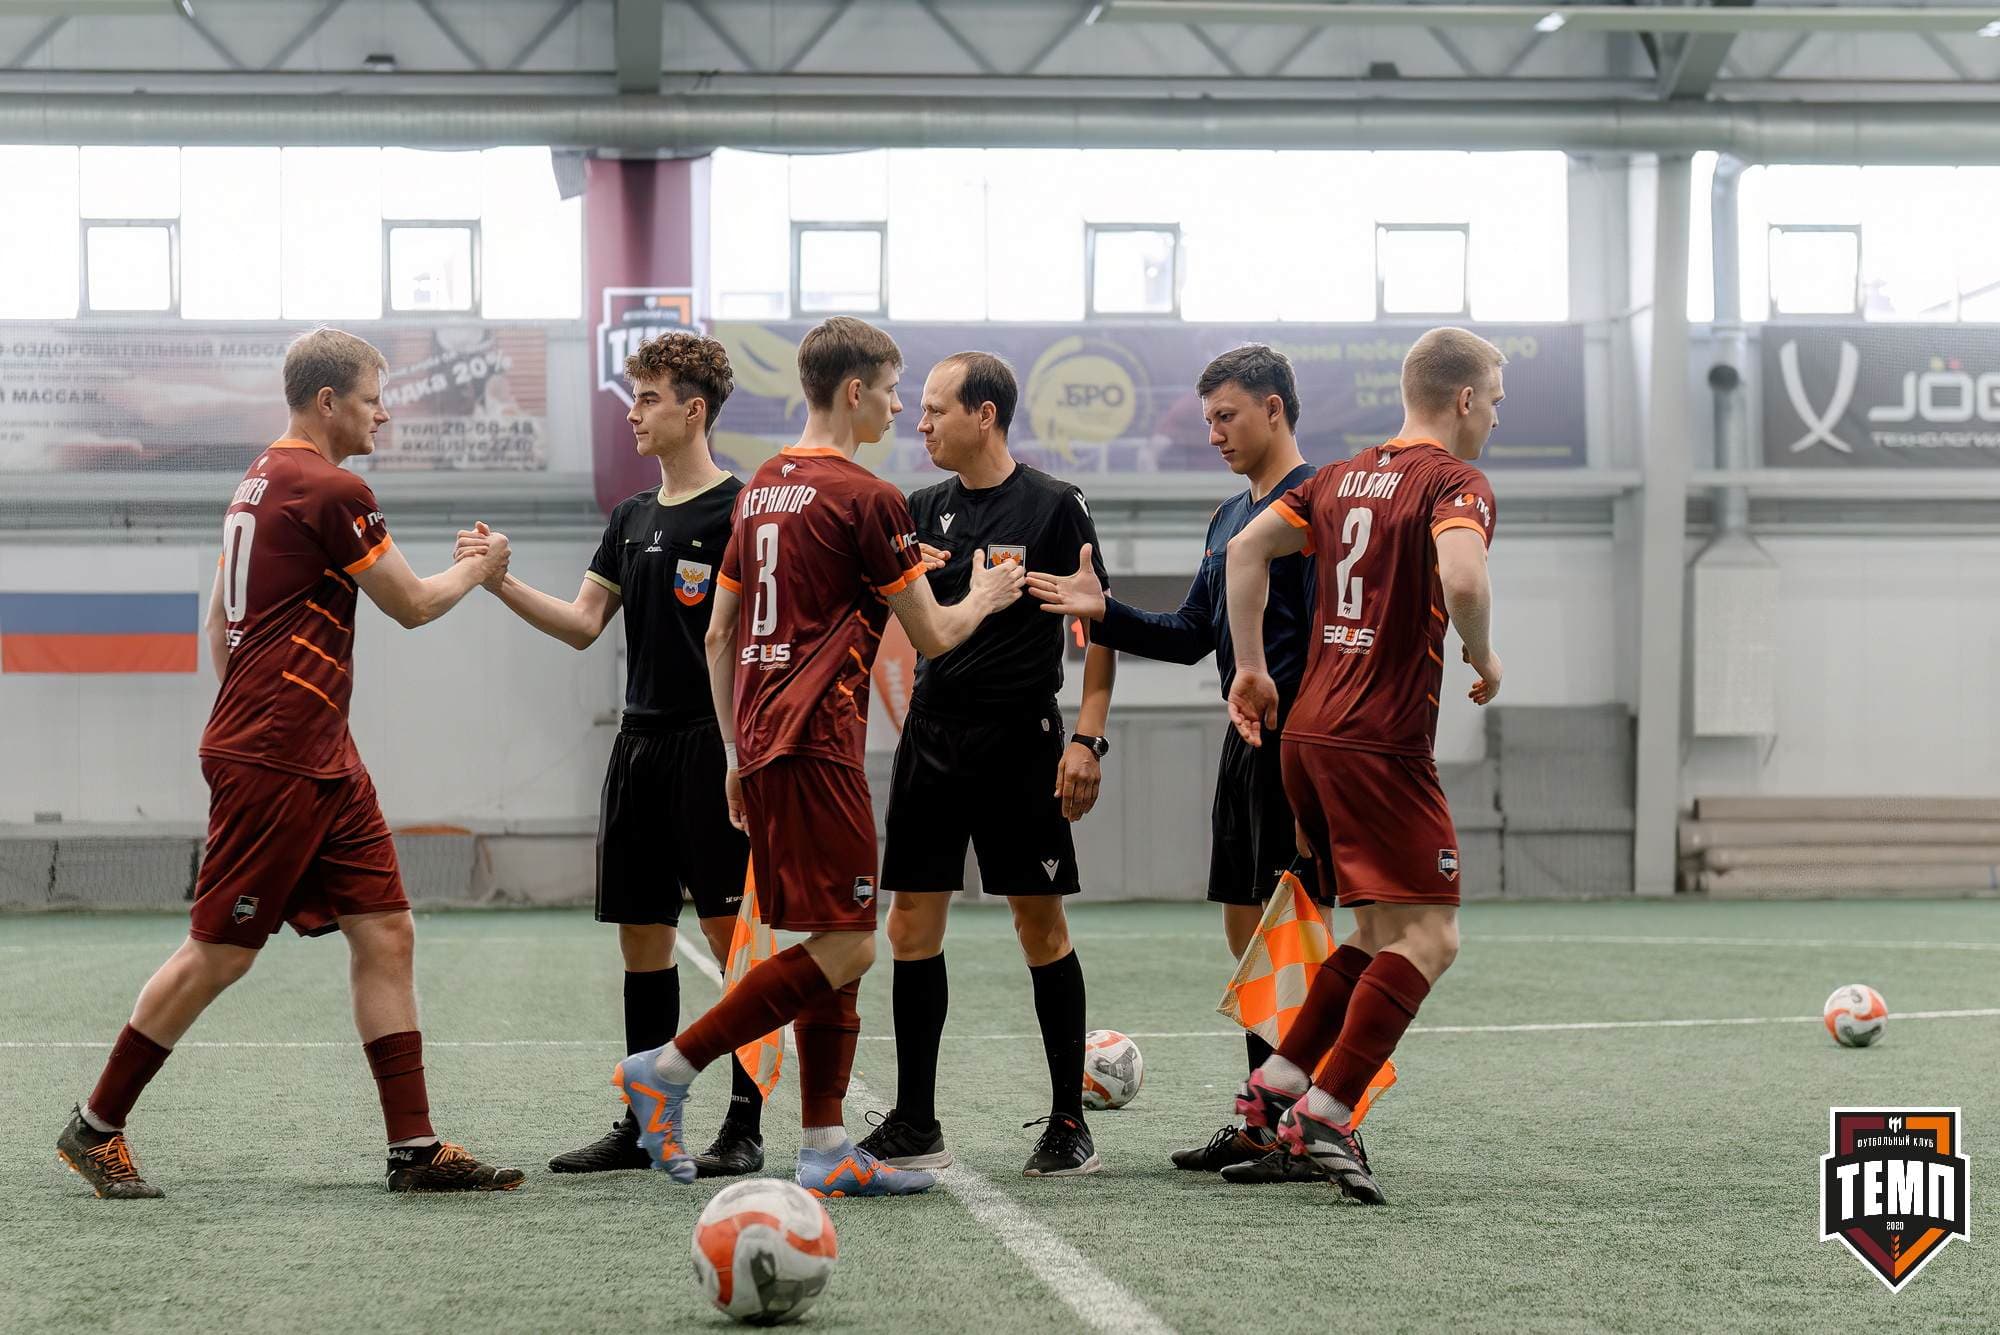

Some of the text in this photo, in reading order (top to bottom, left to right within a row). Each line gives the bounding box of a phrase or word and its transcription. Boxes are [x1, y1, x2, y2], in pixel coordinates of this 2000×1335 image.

[0, 342, 289, 358] -ОЗДОРОВИТЕЛЬНЫЙ МАССА
[451, 350, 514, 385] 20%
[743, 484, 818, 519] ВЕРНИГОР
[751, 522, 779, 636] 3
[1336, 506, 1373, 621] 2
